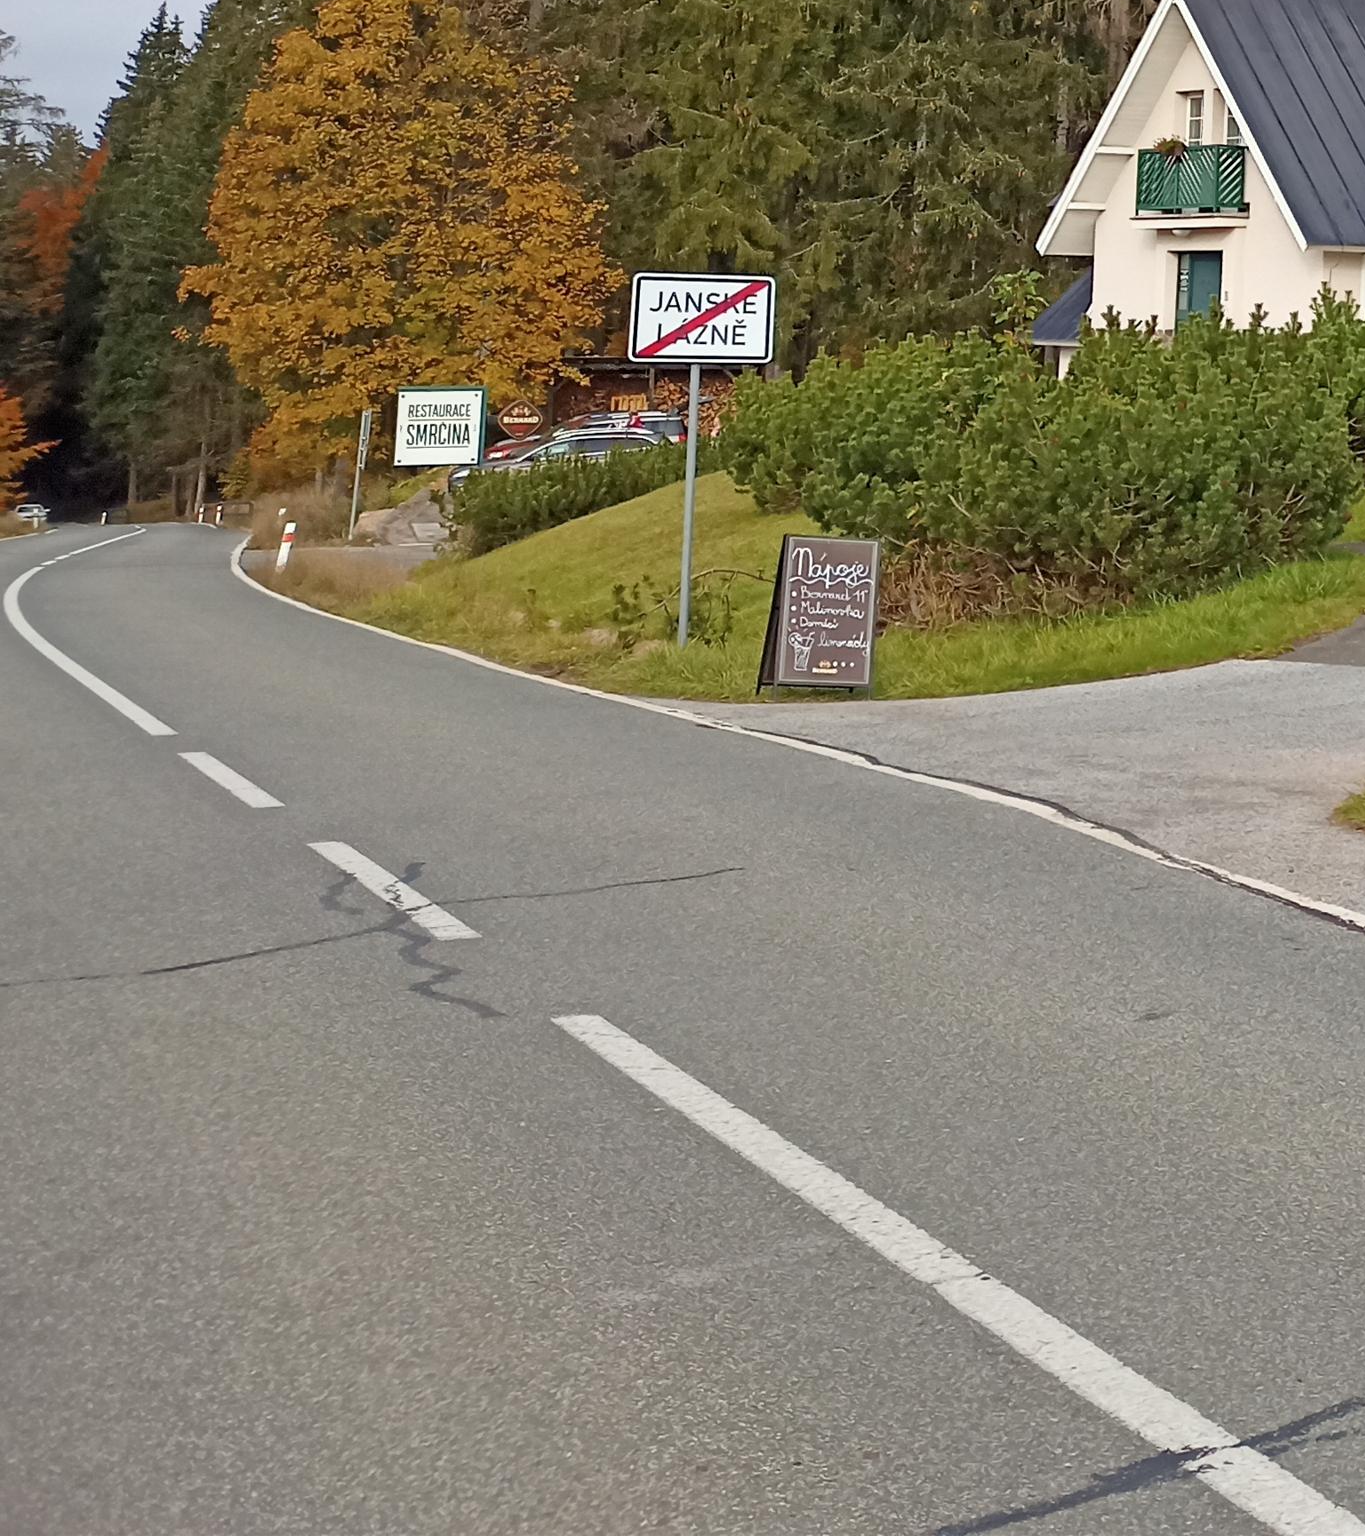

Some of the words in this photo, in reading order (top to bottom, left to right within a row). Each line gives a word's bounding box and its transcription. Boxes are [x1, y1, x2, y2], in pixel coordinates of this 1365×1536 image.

[407, 403, 471, 418] RESTAURACE
[406, 422, 470, 446] SMRČINA
[792, 547, 869, 589] Nápoje
[800, 585, 850, 601] Bernard
[800, 600, 865, 619] Malinovka
